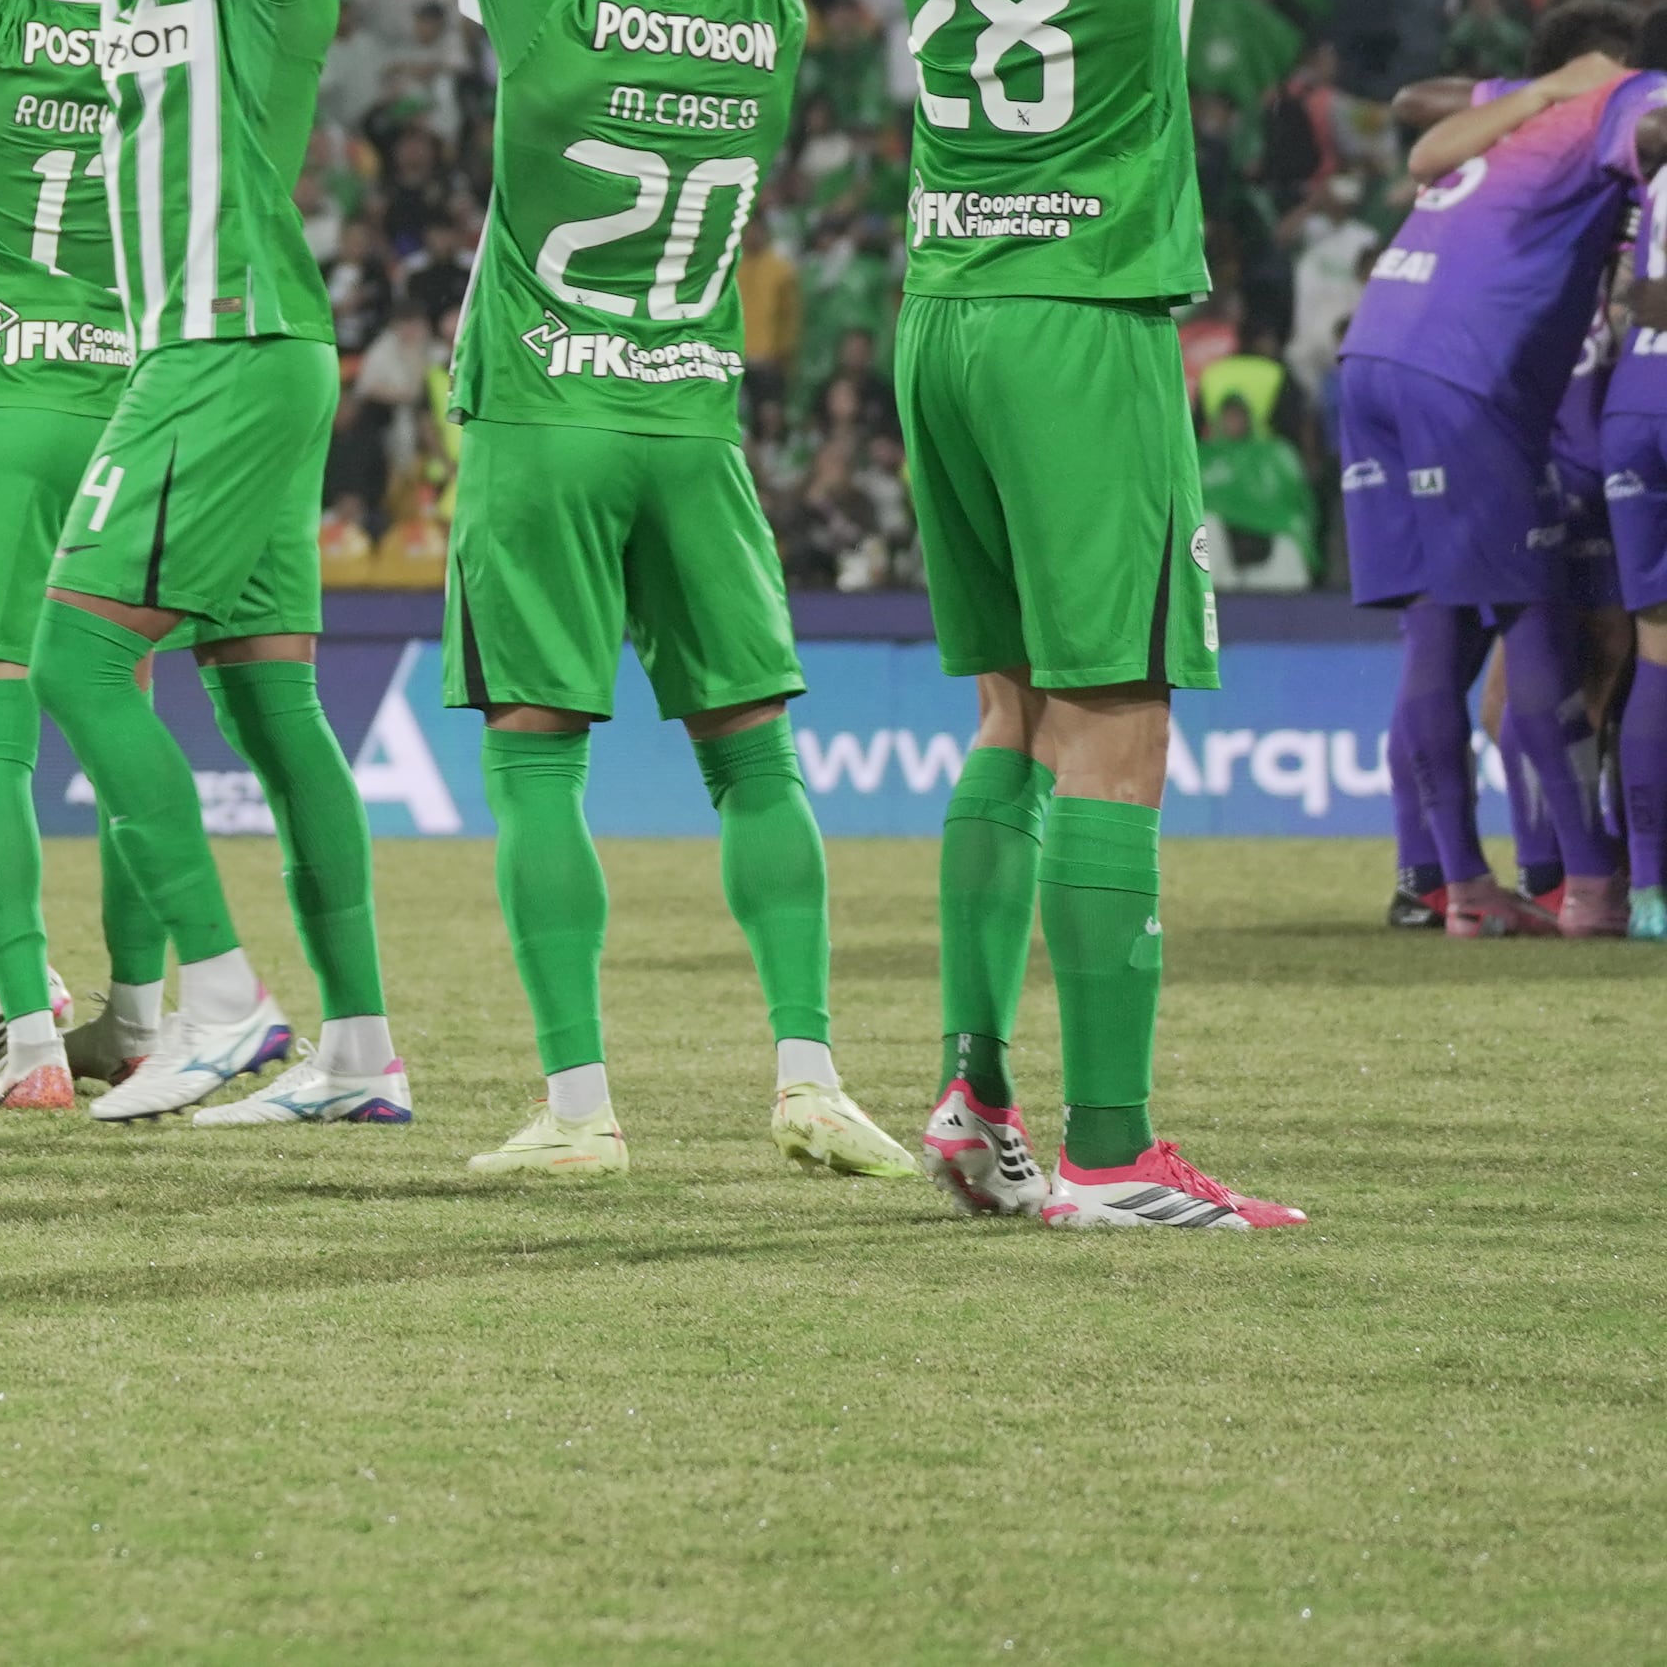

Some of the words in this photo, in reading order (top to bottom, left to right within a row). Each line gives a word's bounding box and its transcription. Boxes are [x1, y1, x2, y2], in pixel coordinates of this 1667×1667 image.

[594, 0, 777, 72] POSTOBON
[965, 191, 1101, 217] Cooperativa
[965, 213, 1071, 238] Financiera
[535, 138, 760, 320] 20
[3, 321, 79, 366] JFK
[546, 334, 631, 377] JFK
[82, 454, 124, 533] 4
